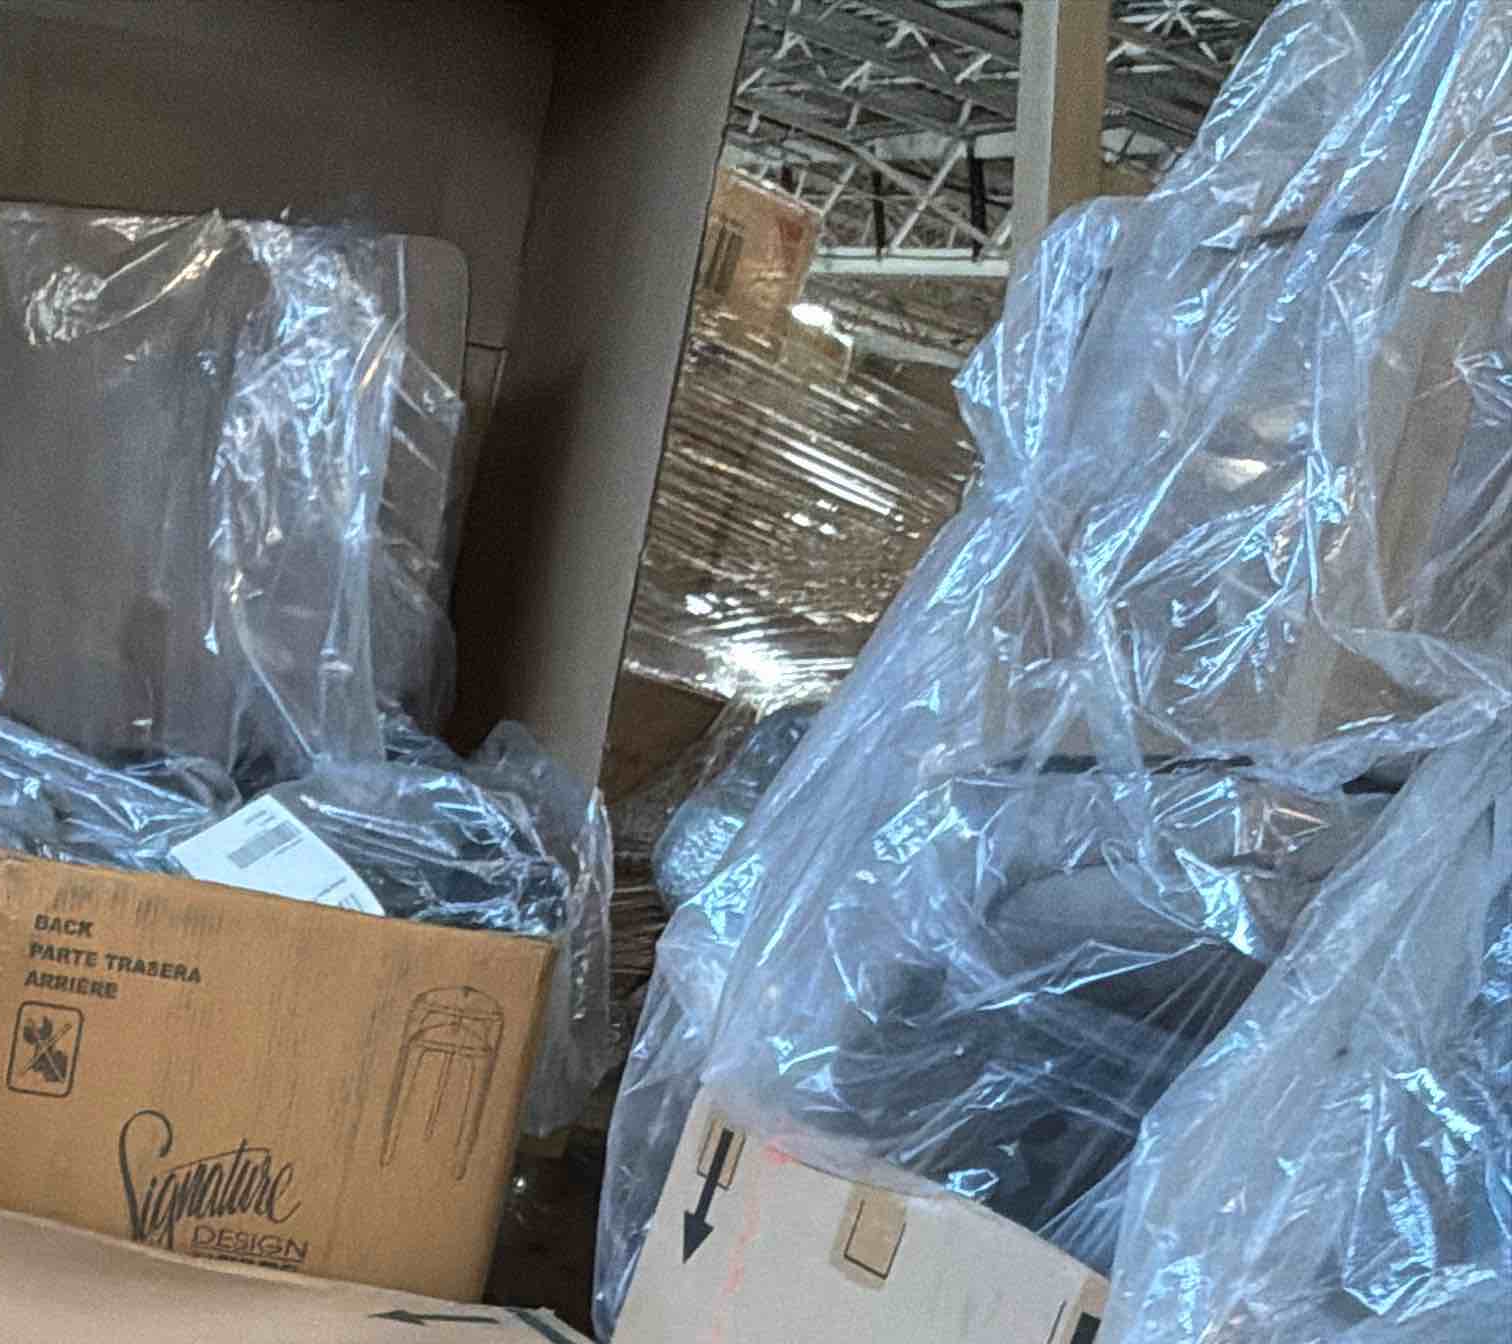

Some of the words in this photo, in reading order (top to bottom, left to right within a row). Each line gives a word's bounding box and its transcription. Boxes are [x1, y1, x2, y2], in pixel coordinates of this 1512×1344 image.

[34, 913, 94, 939] BACK
[28, 942, 98, 968] PARTE
[105, 953, 202, 984] TRASERA
[119, 1109, 301, 1251] Signature
[191, 1224, 310, 1263] DESIGN
